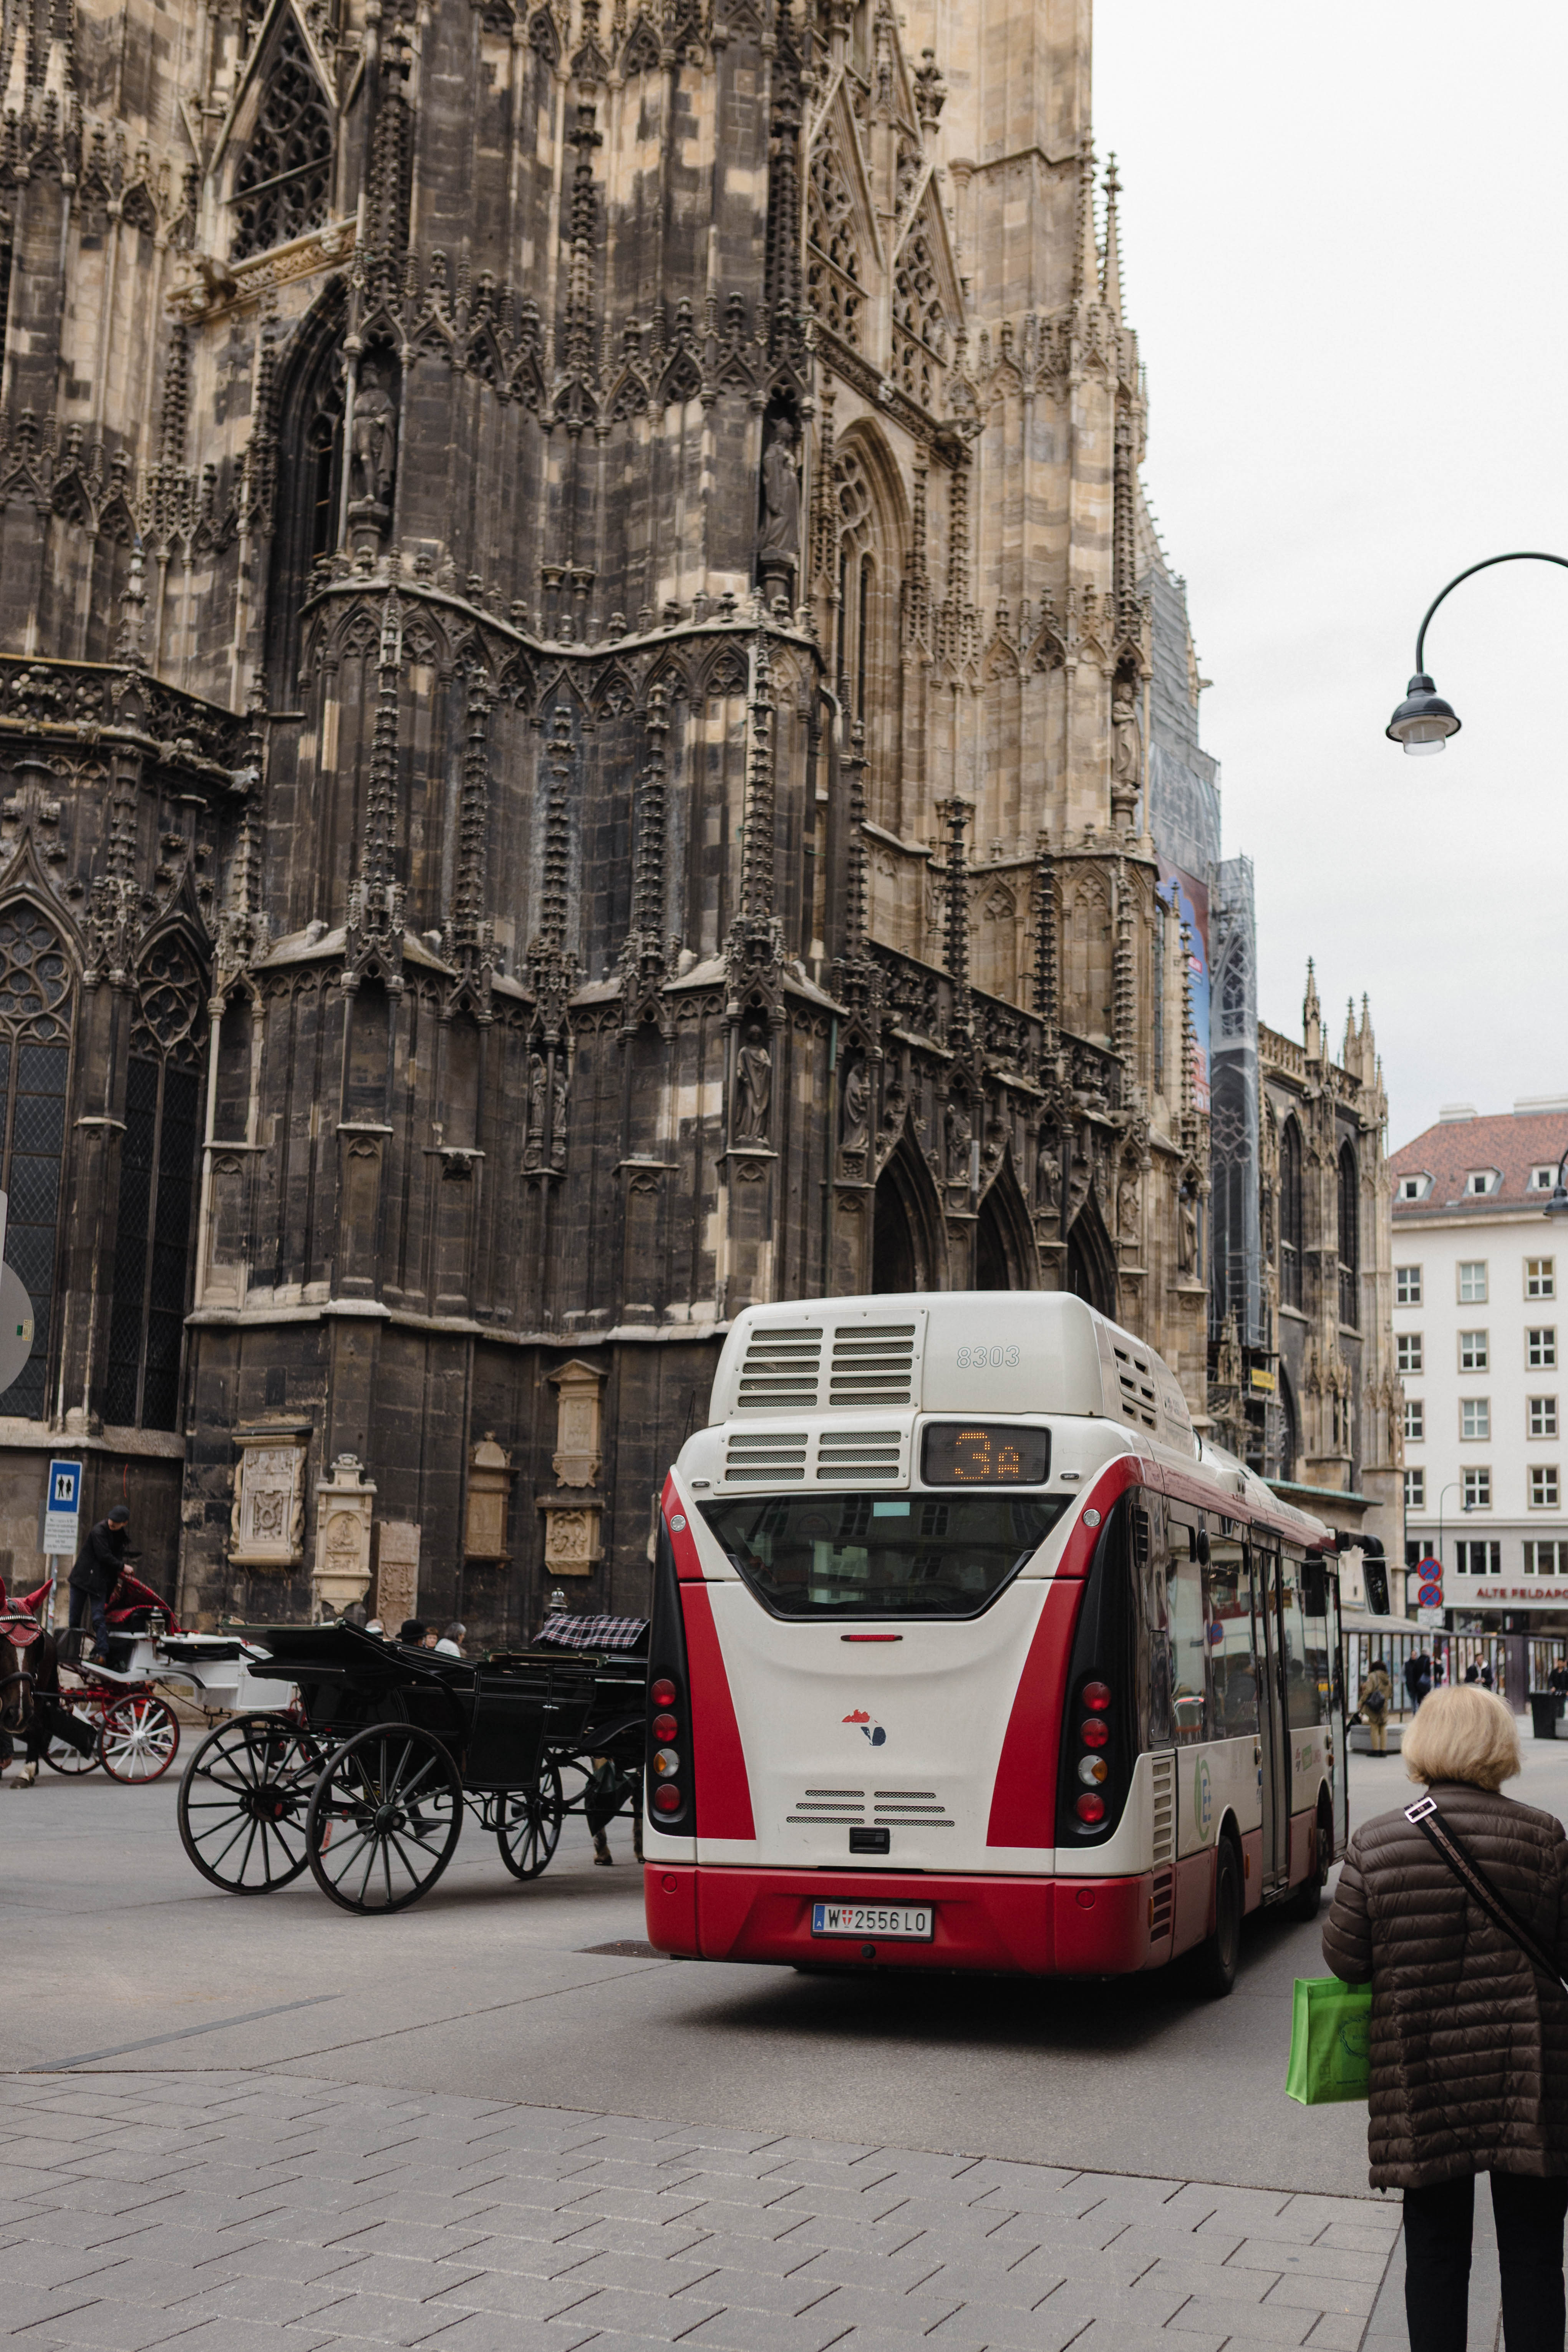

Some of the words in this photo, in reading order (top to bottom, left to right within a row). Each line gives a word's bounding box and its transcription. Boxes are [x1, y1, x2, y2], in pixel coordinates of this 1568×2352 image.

[957, 1345, 1020, 1368] 8303
[955, 1433, 1019, 1479] 3A
[1477, 1587, 1507, 1599] ALTE
[829, 1909, 840, 1928] W
[855, 1910, 899, 1929] 2556
